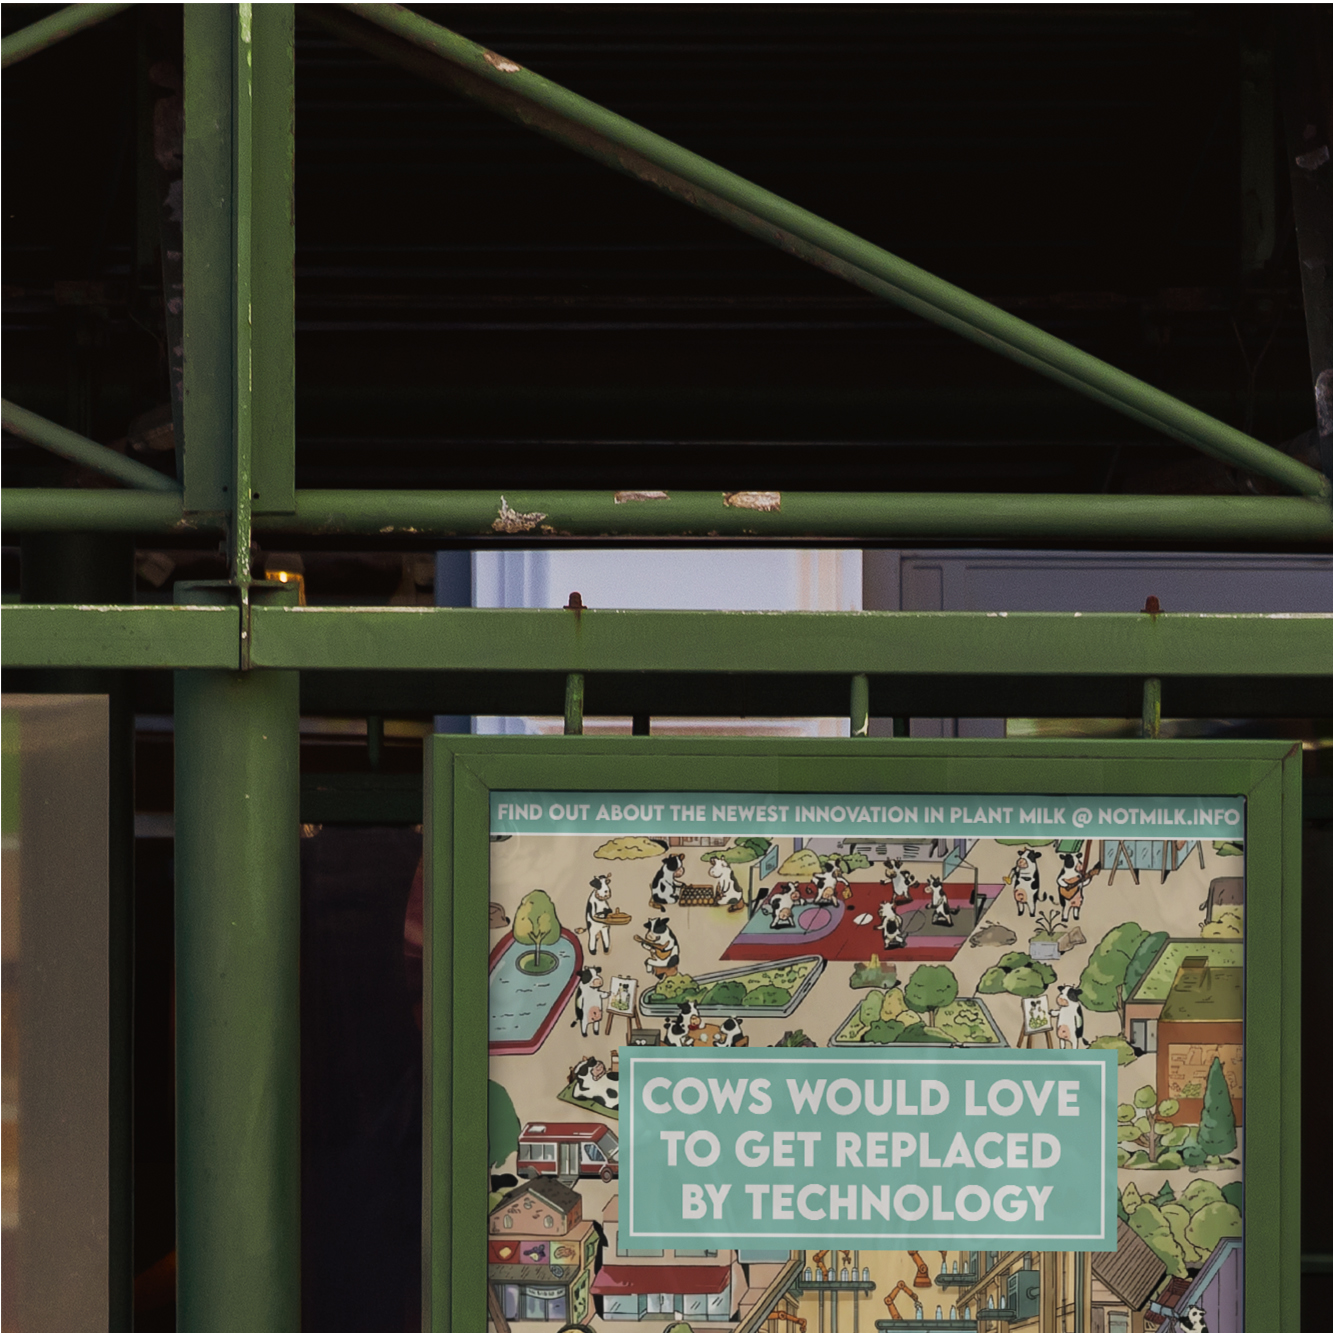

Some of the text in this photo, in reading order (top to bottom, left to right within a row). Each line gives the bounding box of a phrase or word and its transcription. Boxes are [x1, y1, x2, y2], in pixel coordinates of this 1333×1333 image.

[498, 803, 1241, 829] FIND OUT ABOUT THE NEWEST INNOVATION IN PLANT MILK @ NOTMILK.INFO
[642, 1077, 1080, 1117] COWS WOULD LOVE
[660, 1130, 1061, 1169] TO GET REPLACED
[682, 1184, 1054, 1222] BY TECHNOLOGY
